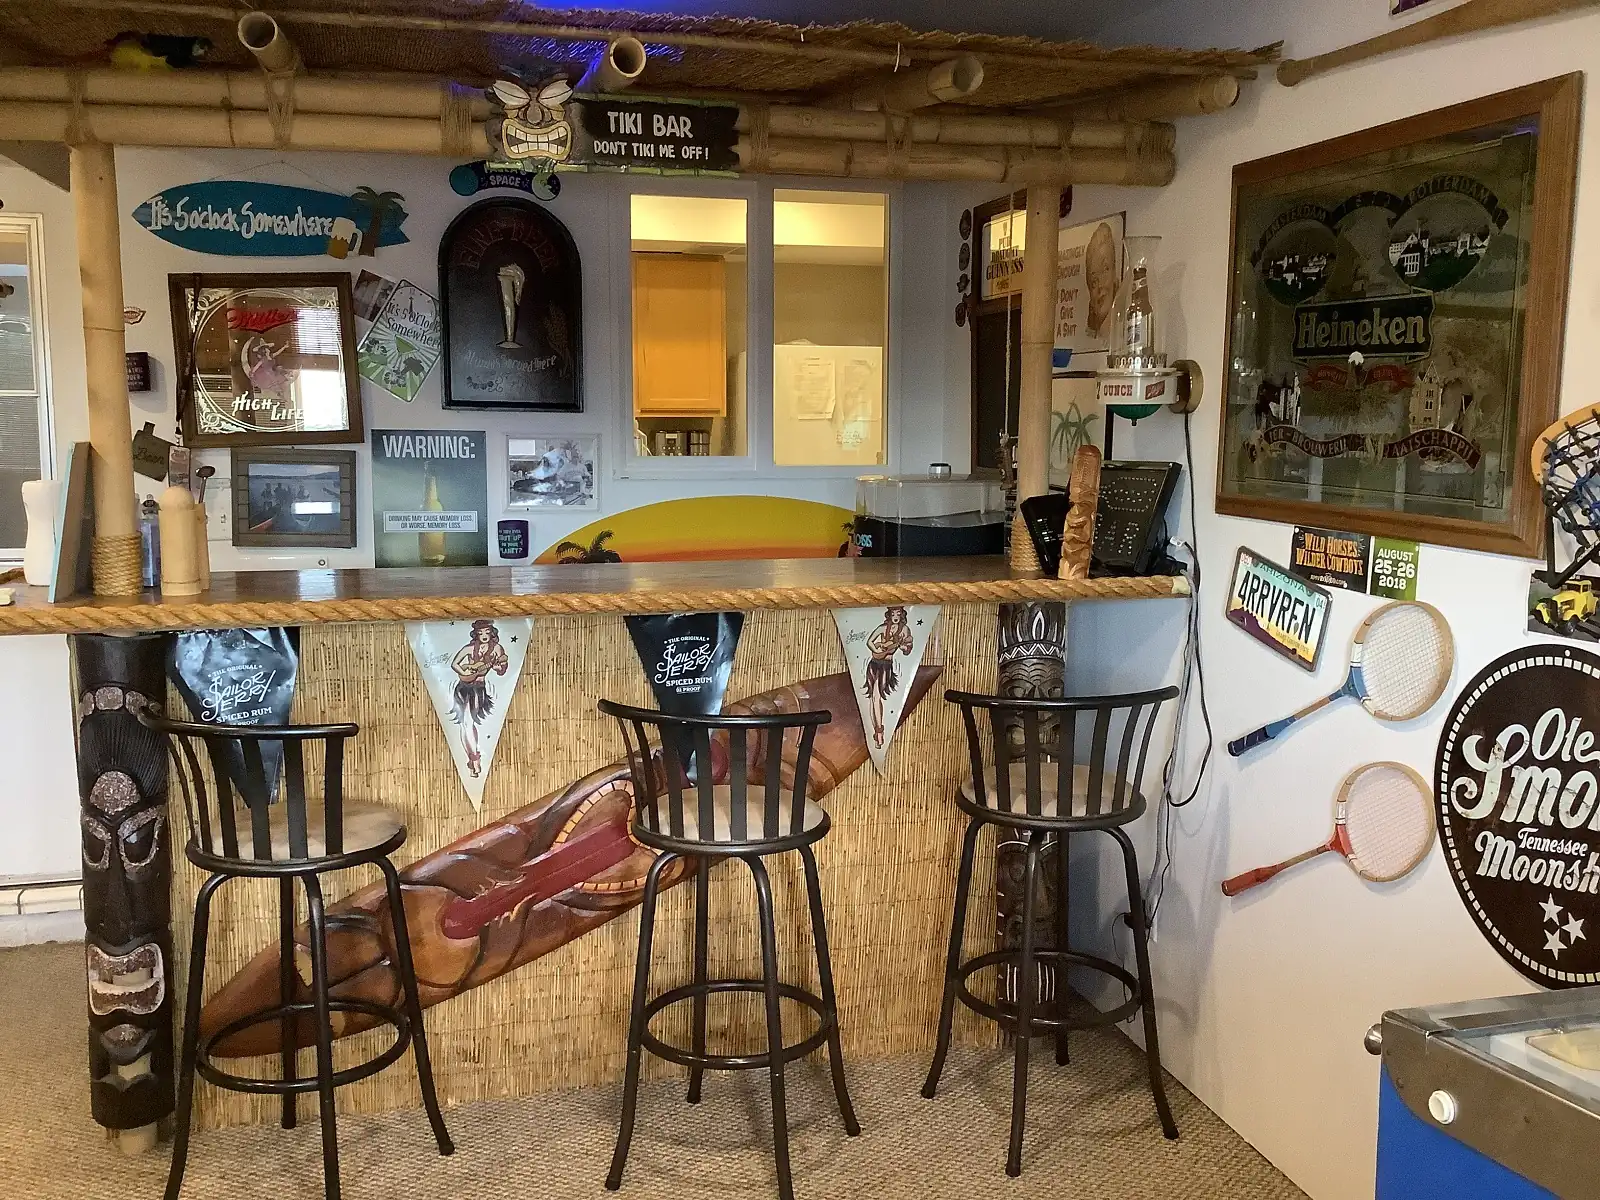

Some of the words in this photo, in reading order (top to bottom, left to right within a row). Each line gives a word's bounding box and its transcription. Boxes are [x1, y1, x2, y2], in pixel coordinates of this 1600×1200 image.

[607, 111, 642, 135] TIKI
[653, 114, 694, 139] BAR
[593, 140, 627, 156] DON'T
[631, 142, 655, 158] TIKI
[659, 144, 676, 158] ME
[489, 175, 521, 187] SPACE
[148, 196, 172, 231] It's
[241, 201, 334, 239] Somewhere
[1060, 288, 1079, 304] DON'T
[386, 302, 400, 318] It's
[1060, 305, 1074, 320] GIVE
[1063, 322, 1077, 337] SHIT
[1297, 308, 1426, 349] Heineken
[1103, 384, 1133, 397] OUNCE
[231, 391, 273, 417] HIGH
[382, 435, 476, 459] WARNING:
[388, 515, 411, 523] DRINKING
[411, 515, 422, 523] MAY
[423, 515, 439, 523] CAUSE
[439, 515, 459, 523] MEMORY
[401, 522, 408, 530] OR
[427, 522, 448, 530] MEMORY
[1304, 532, 1326, 553] WILD
[1296, 548, 1327, 570] WILDER
[1326, 553, 1364, 576] COWBOYS
[1377, 547, 1414, 562] AUGUST
[1258, 562, 1309, 596] ARIZONA
[1373, 559, 1415, 579] 25-26
[1378, 575, 1407, 590] 2018
[656, 643, 711, 672] SAILOR
[211, 668, 226, 677] THE
[226, 664, 258, 672] ORIGINAL
[202, 671, 266, 708] SAILOR
[665, 678, 694, 687] SPICED
[694, 676, 713, 684] RUM
[216, 711, 249, 724] SPICED
[250, 706, 273, 717] RUM
[1531, 707, 1600, 762] Ole
[1451, 722, 1600, 832] Smo
[1517, 827, 1589, 857] Tennessee
[1474, 830, 1600, 895] Moonsh
